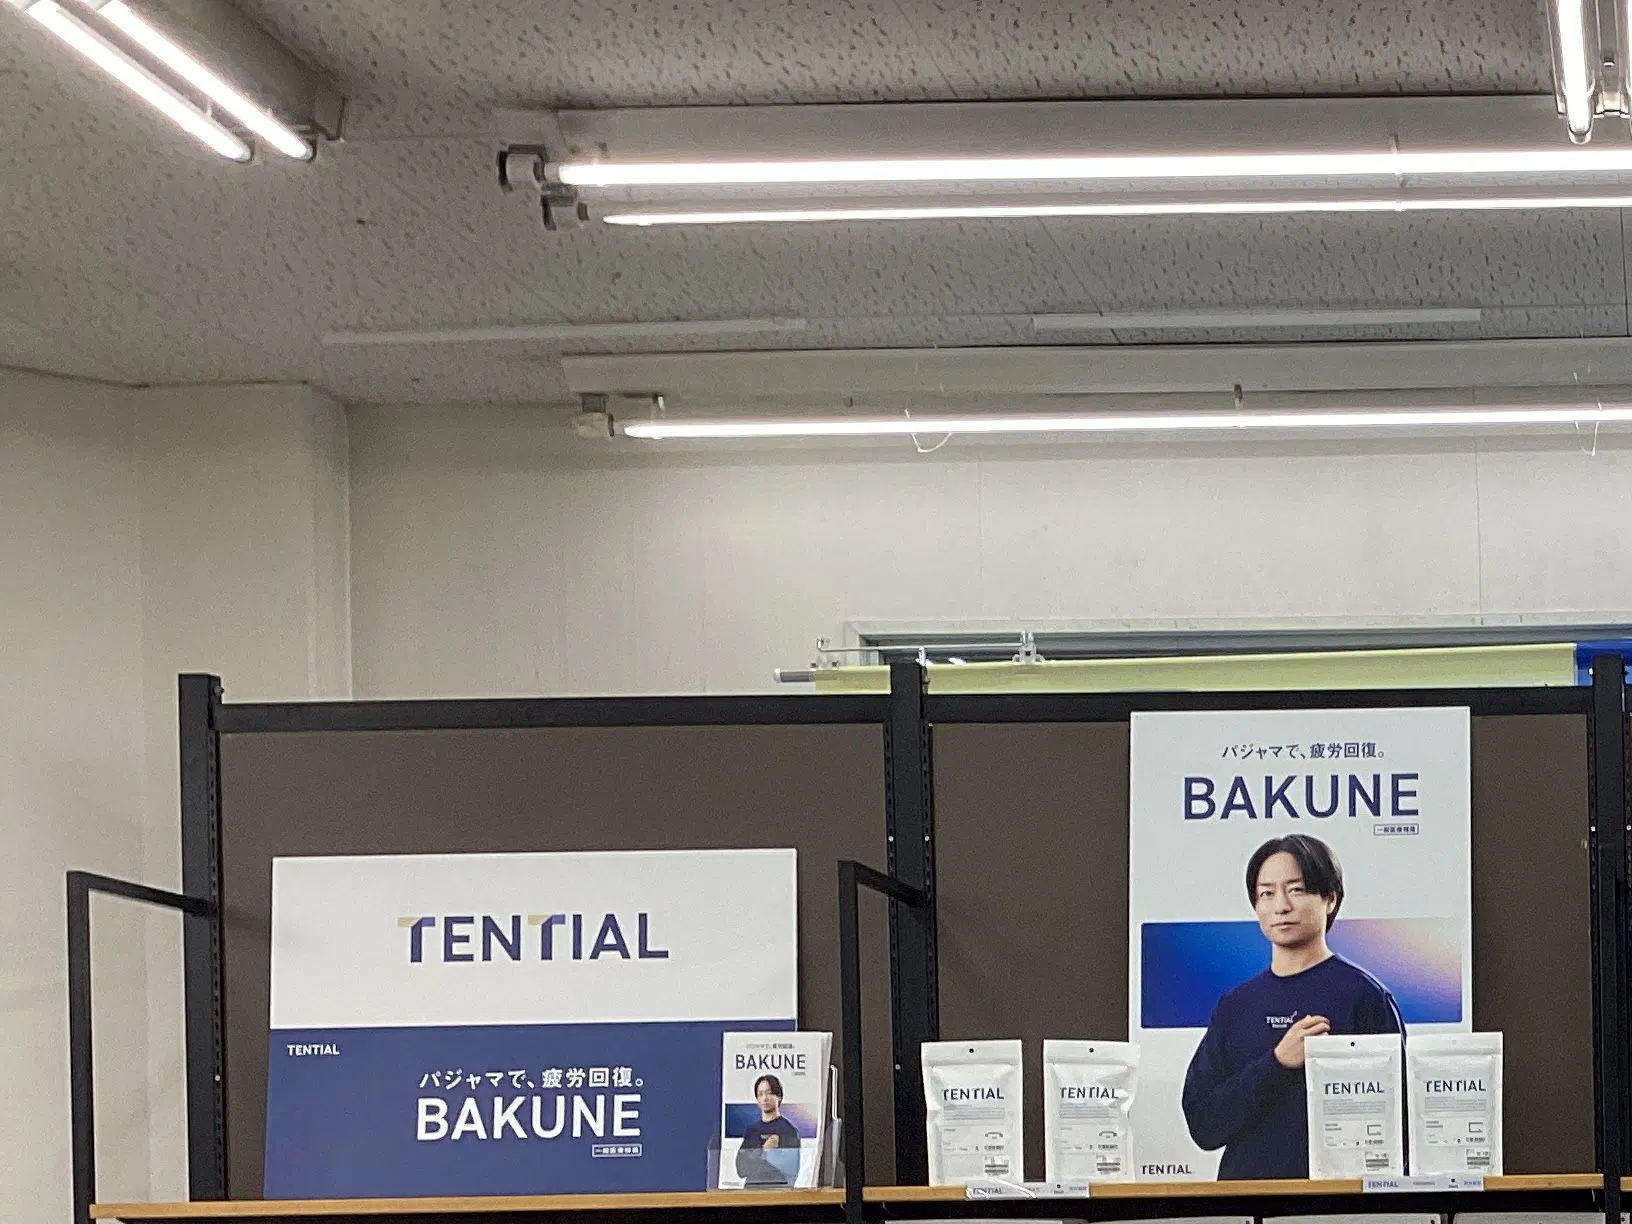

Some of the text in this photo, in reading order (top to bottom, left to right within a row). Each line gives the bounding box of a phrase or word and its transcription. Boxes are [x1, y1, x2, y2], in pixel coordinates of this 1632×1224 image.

[1222, 742, 1385, 760] パジャマで、疲労回復。
[1184, 773, 1419, 820] BAKUNE
[397, 913, 670, 963] TENTIAL
[287, 1043, 340, 1057] TENTIAL
[735, 1054, 807, 1070] BAKUNE
[419, 1066, 644, 1091] パジャマで、疲労回復。
[1425, 1079, 1487, 1093] TENTIAL
[942, 1087, 1005, 1102] TENTIAL
[1060, 1086, 1119, 1100] TENTIAL
[1323, 1081, 1385, 1095] TENTIAL
[417, 1094, 641, 1141] BAKUNE
[1141, 1165, 1192, 1175] TENTIAL
